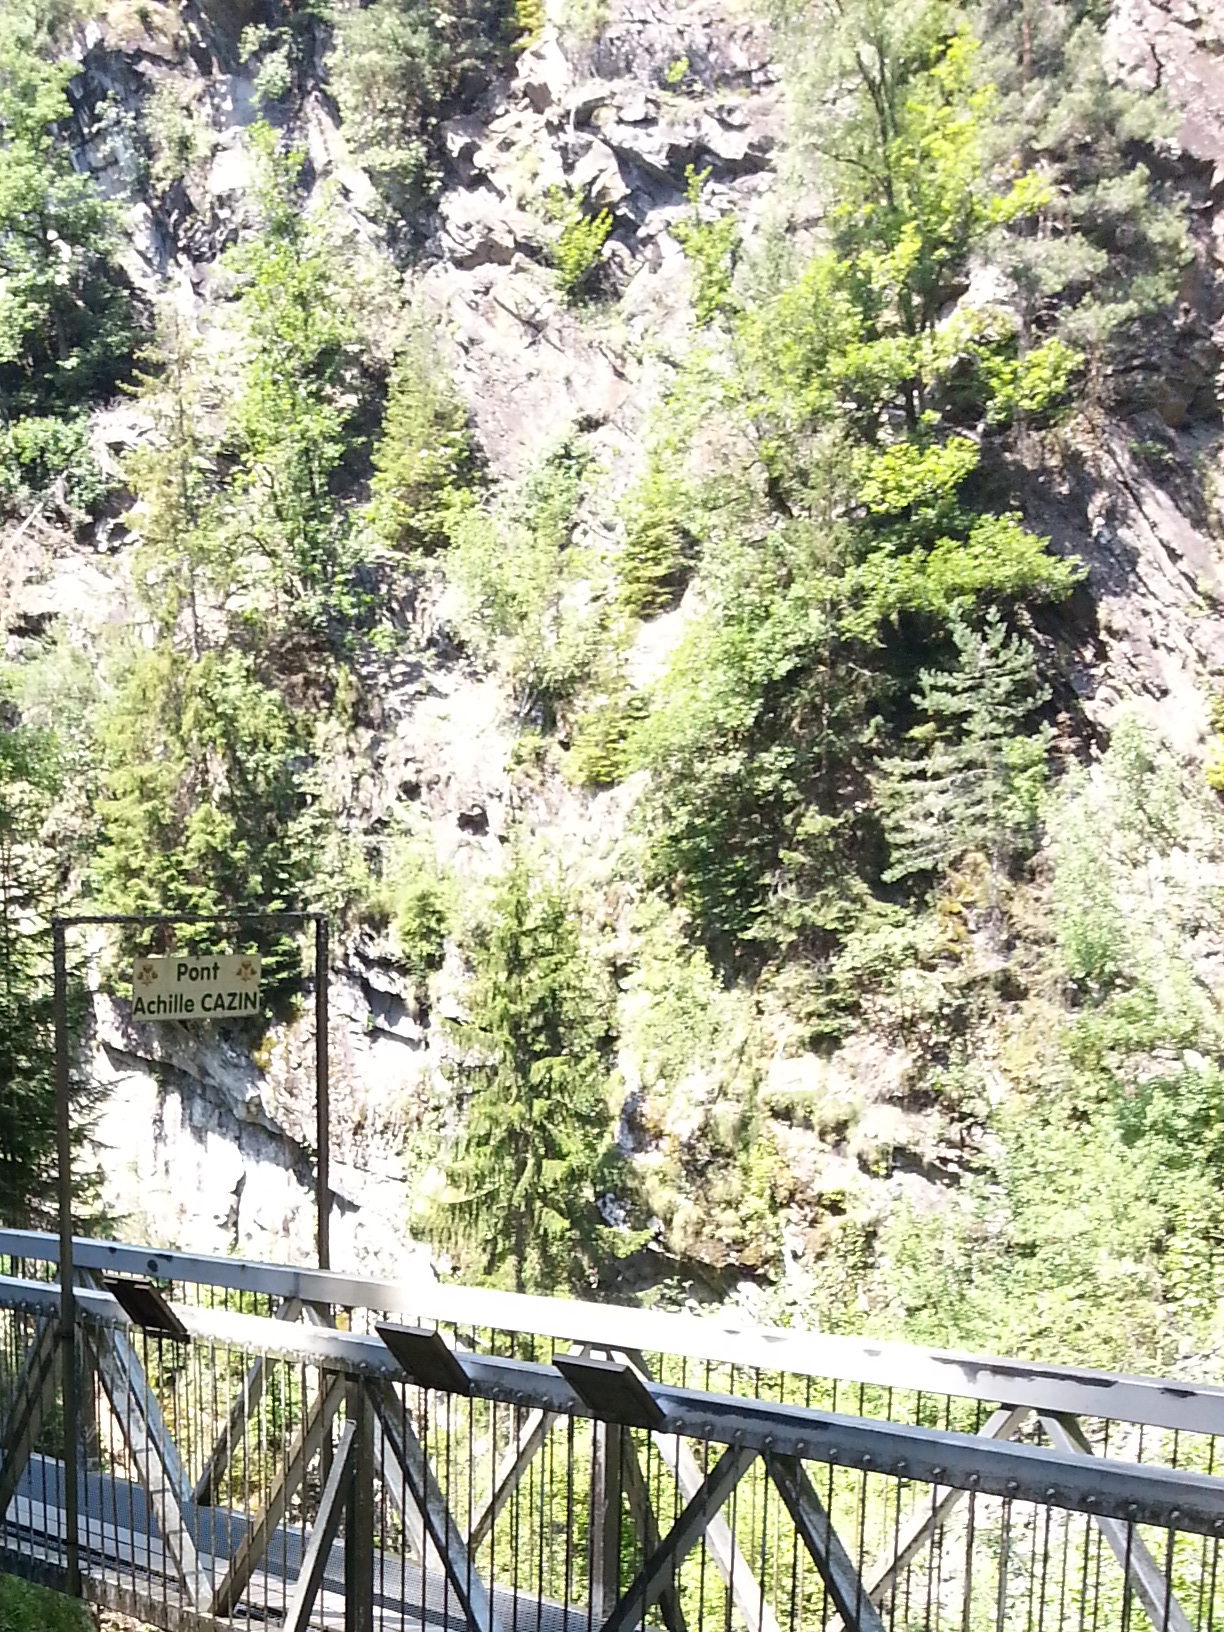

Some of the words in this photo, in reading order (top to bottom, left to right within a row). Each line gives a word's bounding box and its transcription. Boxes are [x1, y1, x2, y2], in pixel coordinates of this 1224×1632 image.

[177, 962, 220, 982] Pont
[133, 994, 195, 1015] Achille
[201, 992, 257, 1012] CAZIN
